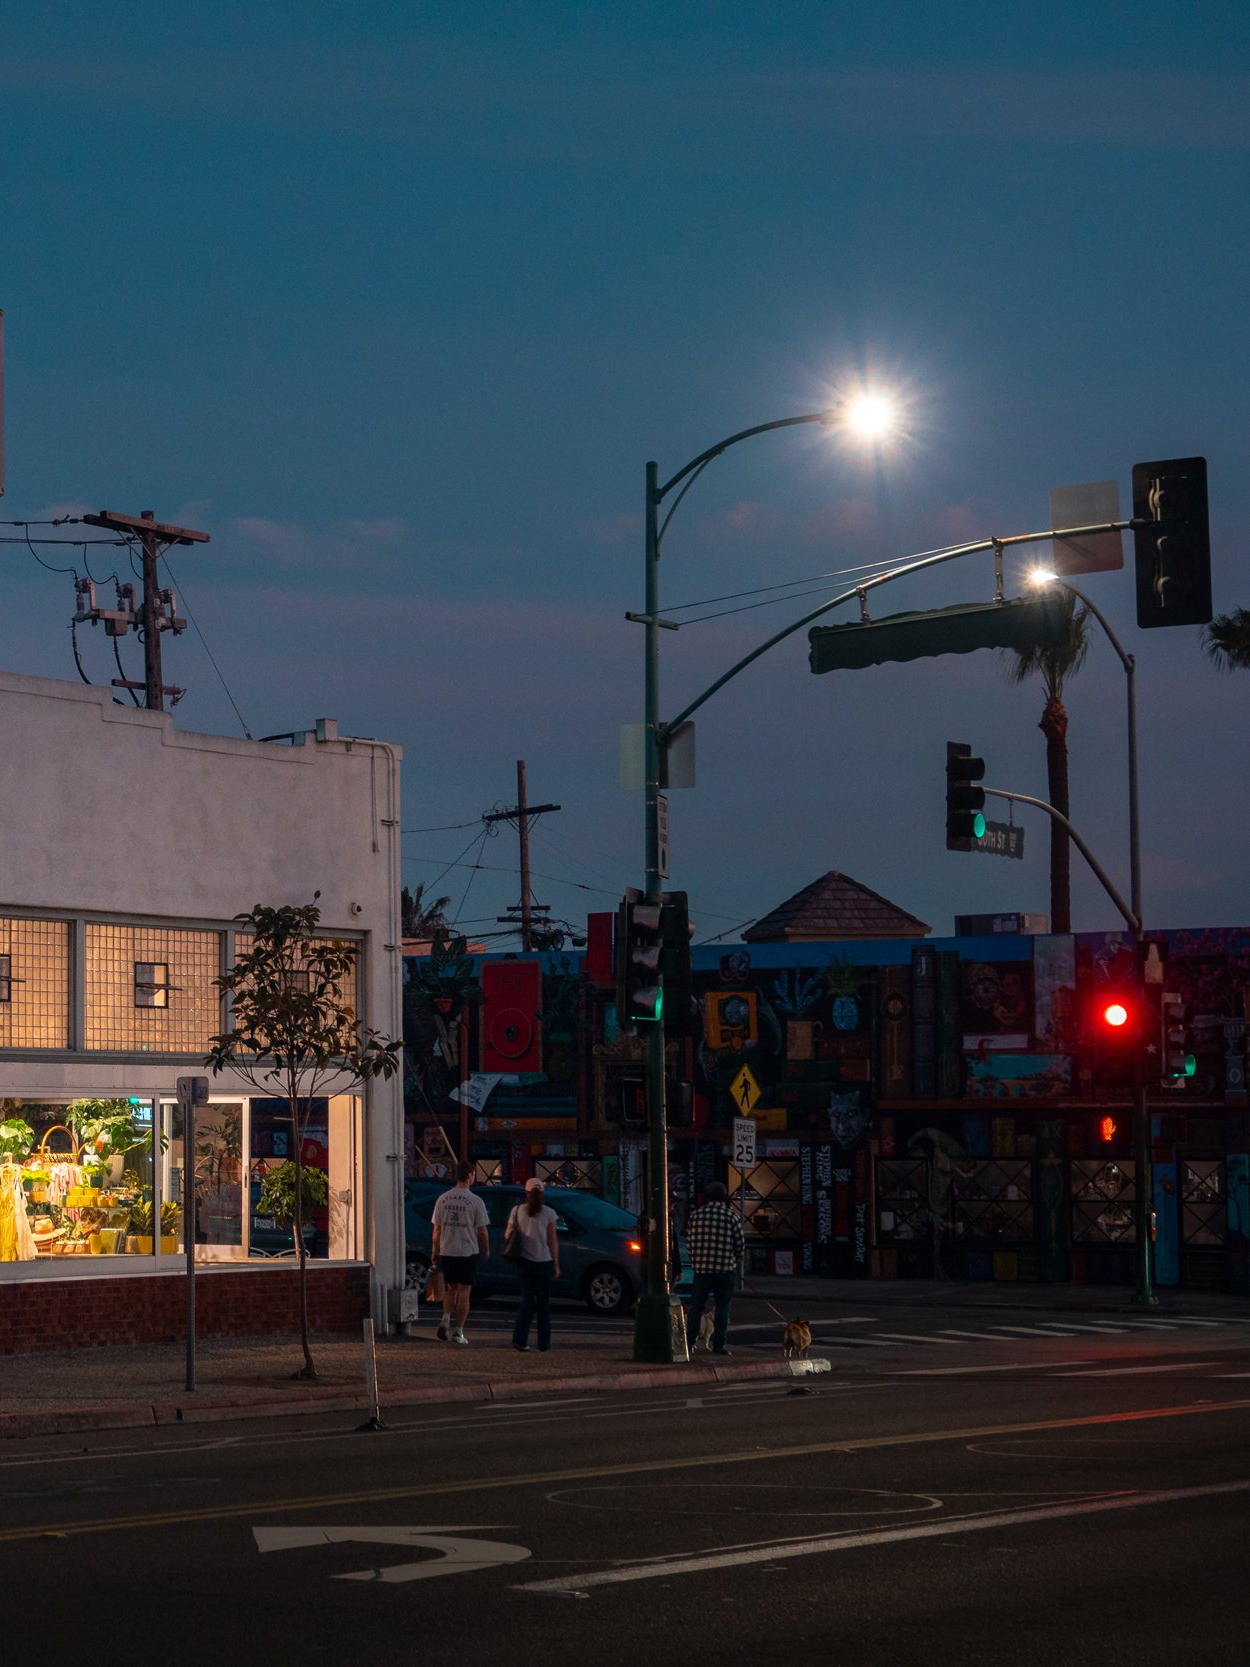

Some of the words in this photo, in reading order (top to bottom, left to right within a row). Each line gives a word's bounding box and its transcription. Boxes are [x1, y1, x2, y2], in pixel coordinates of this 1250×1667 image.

[736, 1123, 754, 1133] SPEED
[738, 1134, 752, 1143] LIMIT
[736, 1144, 753, 1163] 25
[801, 1146, 813, 1184] STEPHEN
[815, 1151, 824, 1181] KING
[821, 1144, 831, 1187] STEPHEN
[801, 1184, 813, 1205] KING
[855, 1203, 866, 1225] PET
[802, 1242, 813, 1271] VIKING
